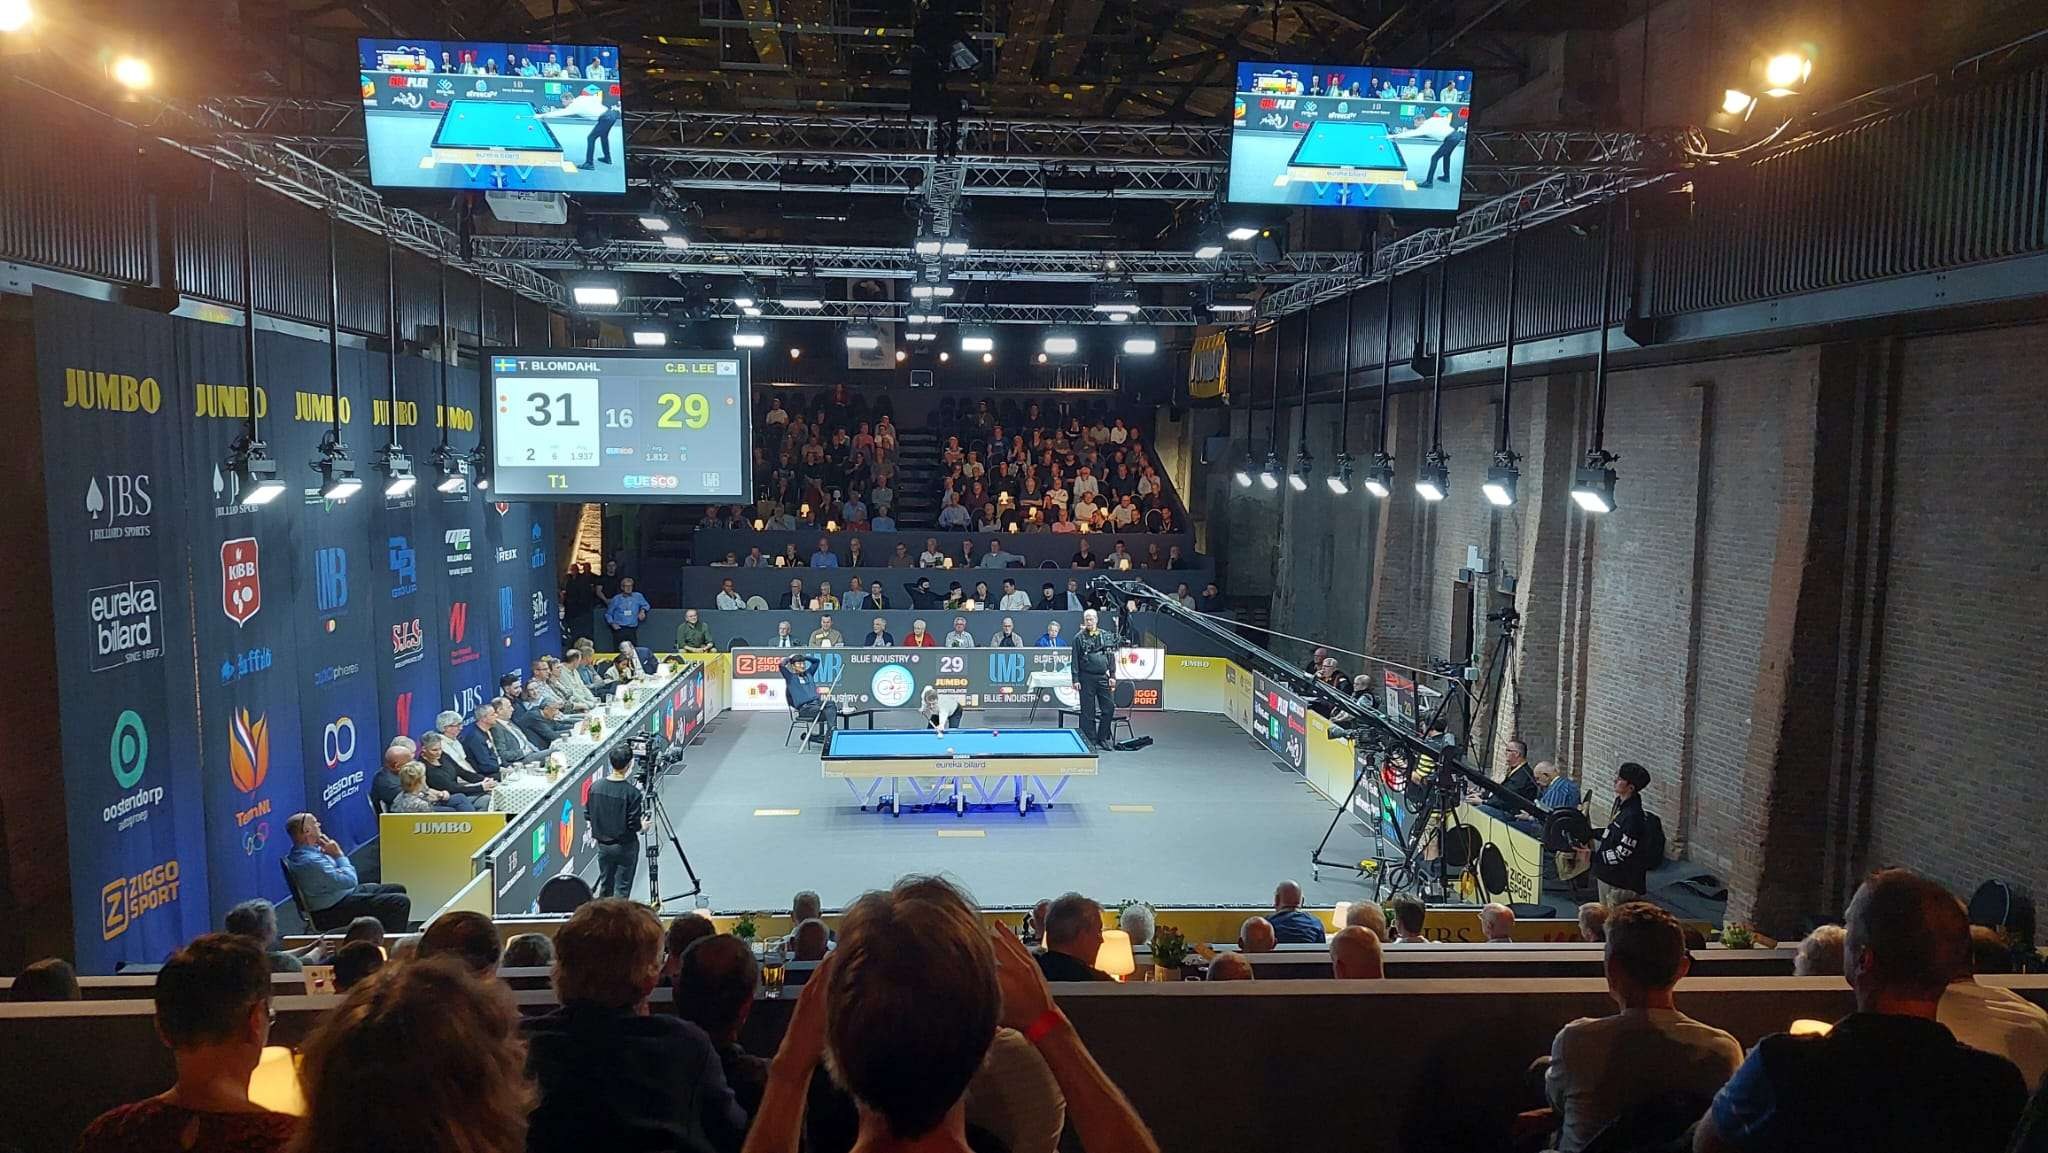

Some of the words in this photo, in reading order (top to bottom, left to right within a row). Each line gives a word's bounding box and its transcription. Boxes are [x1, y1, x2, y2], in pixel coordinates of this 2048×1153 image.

[518, 361, 527, 371] T.
[531, 361, 601, 372] BLOMDAHL
[665, 363, 689, 374] C.B.
[692, 364, 715, 374] LEE
[64, 368, 161, 414] JUMBO
[526, 391, 580, 427] 31
[657, 392, 710, 430] 29
[605, 408, 633, 429] 16
[526, 447, 536, 461] 2
[547, 474, 569, 488] T1
[623, 475, 679, 489] CUESCO
[107, 475, 152, 527] JBS
[91, 581, 157, 622] eureka
[98, 616, 151, 655] billard
[851, 654, 871, 664] BLUE
[872, 654, 911, 664] INDUSTRY
[940, 656, 964, 673] 29
[757, 664, 780, 673] SPO
[935, 678, 968, 687] JUMBO
[984, 694, 1003, 703] BLUE
[1134, 689, 1158, 697] IGGO
[1134, 697, 1157, 705] PORT
[935, 761, 962, 769] eureka
[963, 760, 986, 769] billard
[104, 786, 163, 822] oostendorp
[413, 821, 472, 834] JUMBO
[129, 860, 179, 899] ZIGGO
[1510, 869, 1533, 891] ZIGGO
[130, 881, 180, 918] SPORT
[1509, 884, 1533, 905] SPORT
